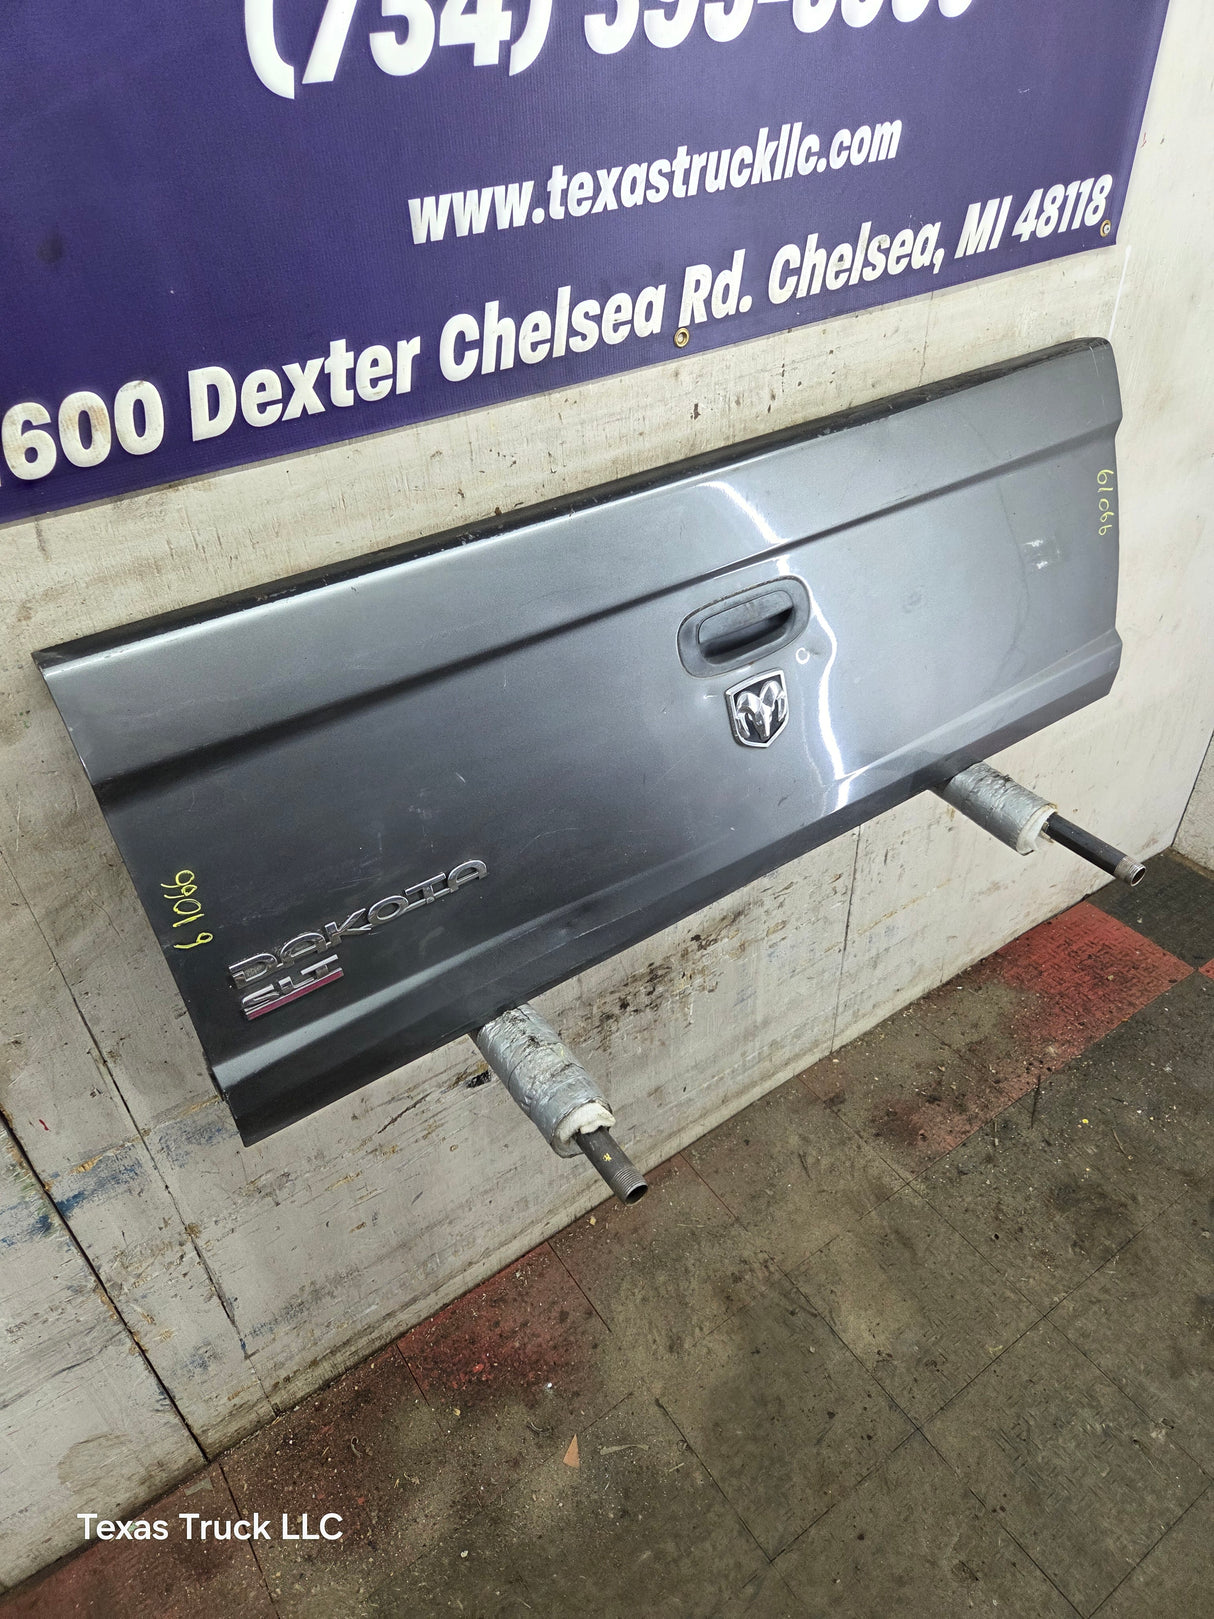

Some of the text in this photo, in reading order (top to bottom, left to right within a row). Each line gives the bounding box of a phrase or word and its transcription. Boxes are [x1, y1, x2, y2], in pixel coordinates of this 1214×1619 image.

[407, 119, 903, 245] www.texastruckllc.com
[0, 173, 1113, 487] 600 Dexter Chelsea Rd. Chelsea, MI 48118
[1096, 469, 1115, 536] 61066
[160, 869, 214, 950] 61066
[228, 859, 488, 988] DAKOTA
[241, 953, 341, 1016] SLT
